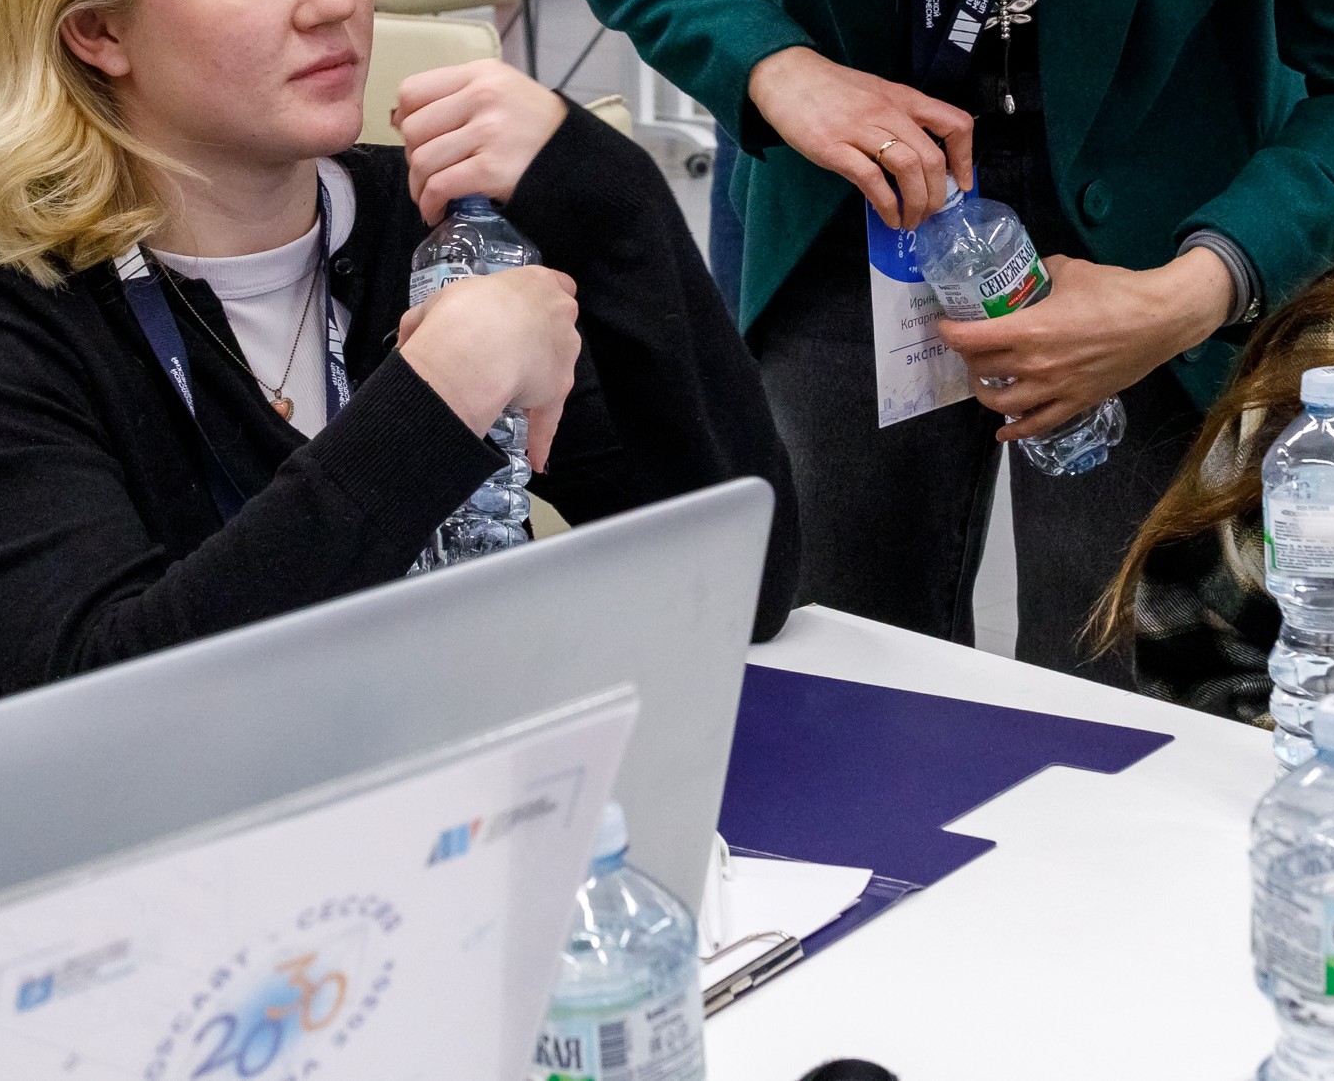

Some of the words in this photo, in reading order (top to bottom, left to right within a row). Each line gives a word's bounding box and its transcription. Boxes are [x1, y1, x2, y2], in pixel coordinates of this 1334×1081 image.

[979, 240, 1036, 298] СЕНЕЖСКАЯ
[910, 296, 937, 309] Ирин
[906, 344, 950, 365] ЭКСПЕР
[336, 365, 345, 408] МЕТОДИЧЕС
